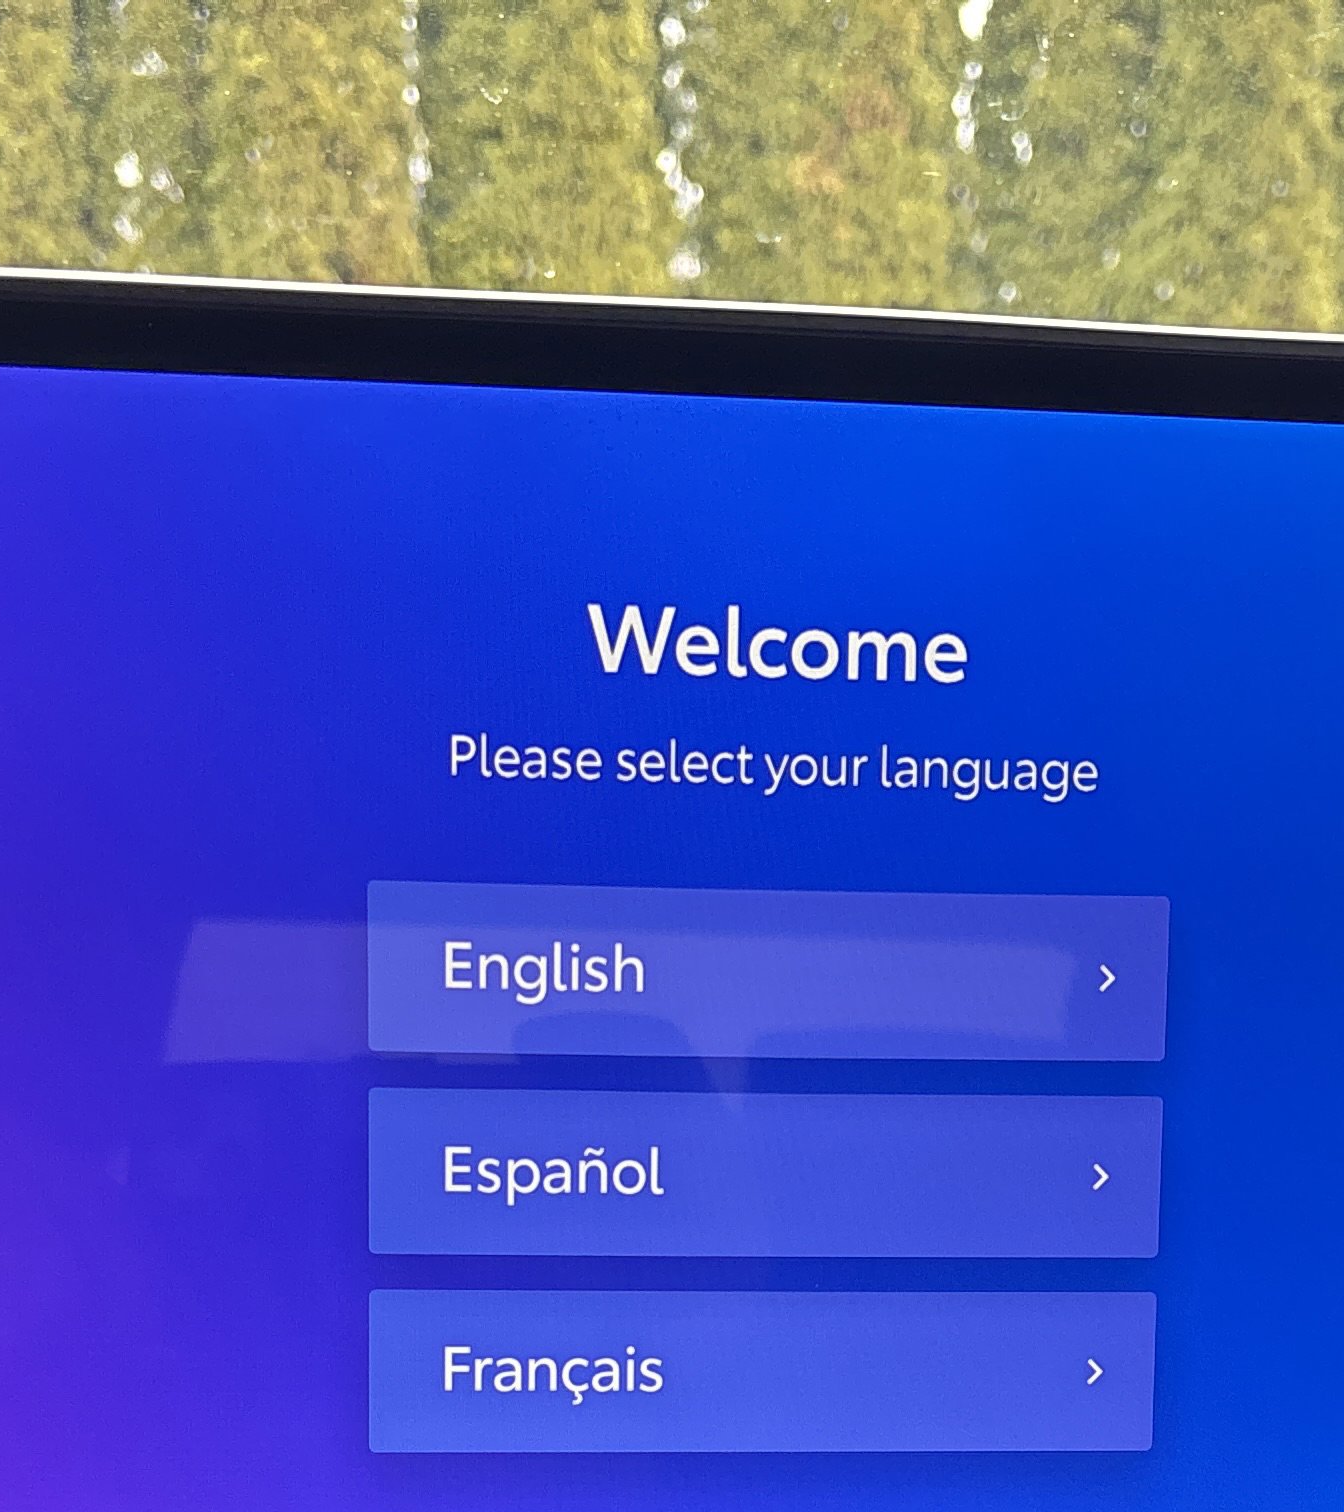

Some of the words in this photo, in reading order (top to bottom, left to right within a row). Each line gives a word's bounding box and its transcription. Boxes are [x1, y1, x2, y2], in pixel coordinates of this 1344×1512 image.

[587, 603, 968, 684] Welcome
[450, 733, 602, 780] Please
[616, 738, 754, 785] select
[764, 755, 868, 796] your
[880, 745, 1099, 803] language
[444, 941, 645, 1004] English
[444, 1146, 665, 1206] Español
[444, 1345, 664, 1406] Français
